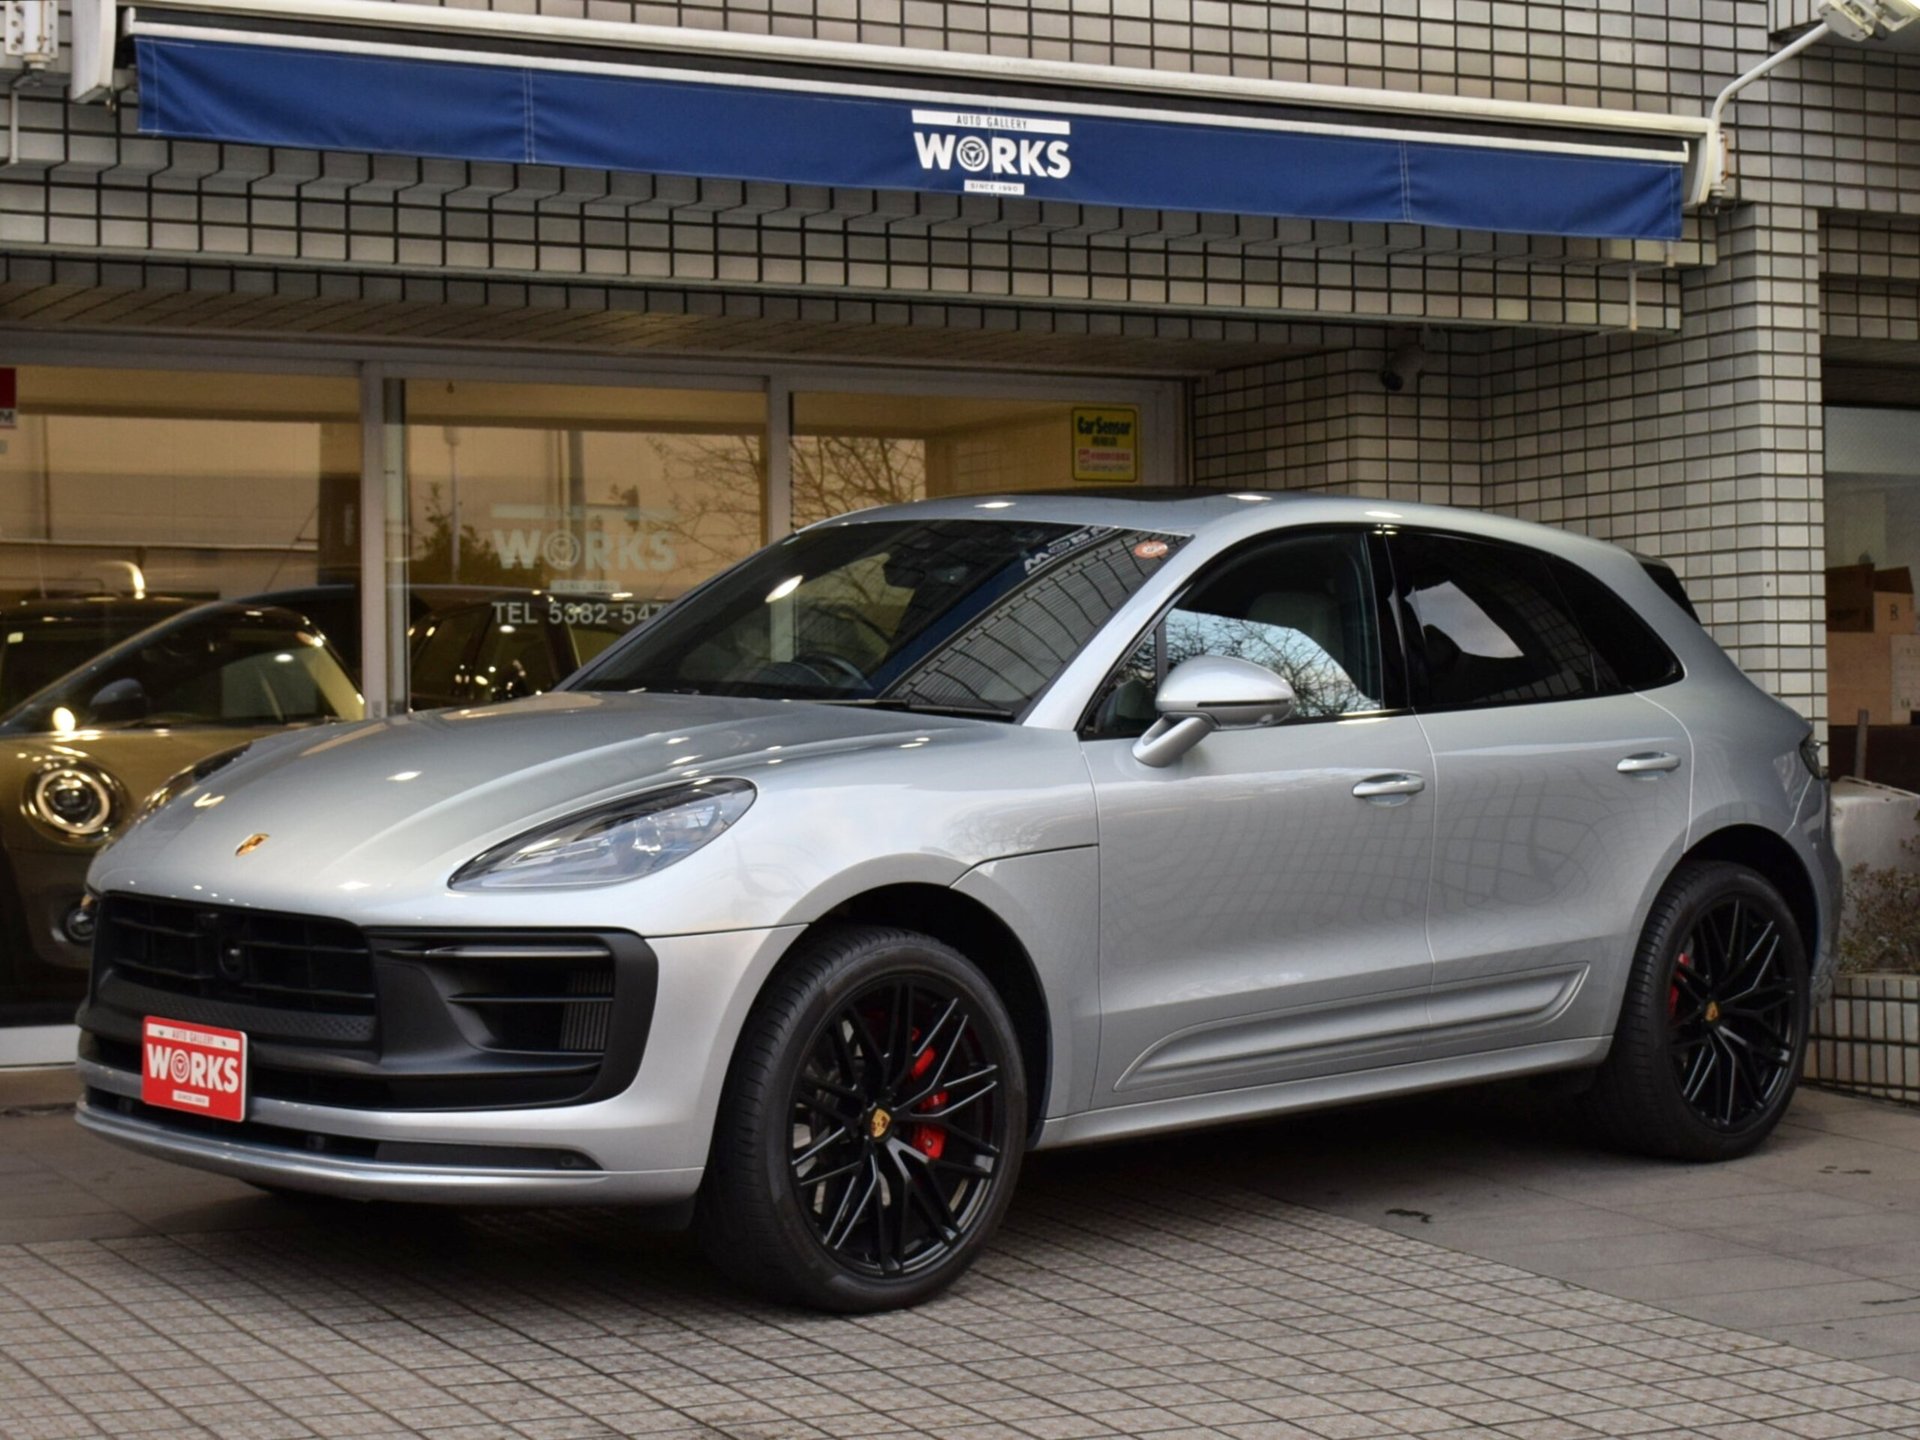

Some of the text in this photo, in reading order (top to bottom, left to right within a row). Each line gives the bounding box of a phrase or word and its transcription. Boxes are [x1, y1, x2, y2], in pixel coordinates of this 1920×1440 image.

[956, 114, 1028, 130] AUTO GALLERY
[913, 131, 1071, 179] WORKS
[970, 182, 994, 191] SINCE
[493, 528, 677, 571] WORKS
[491, 602, 538, 624] TEL
[146, 1043, 239, 1093] WORKS
